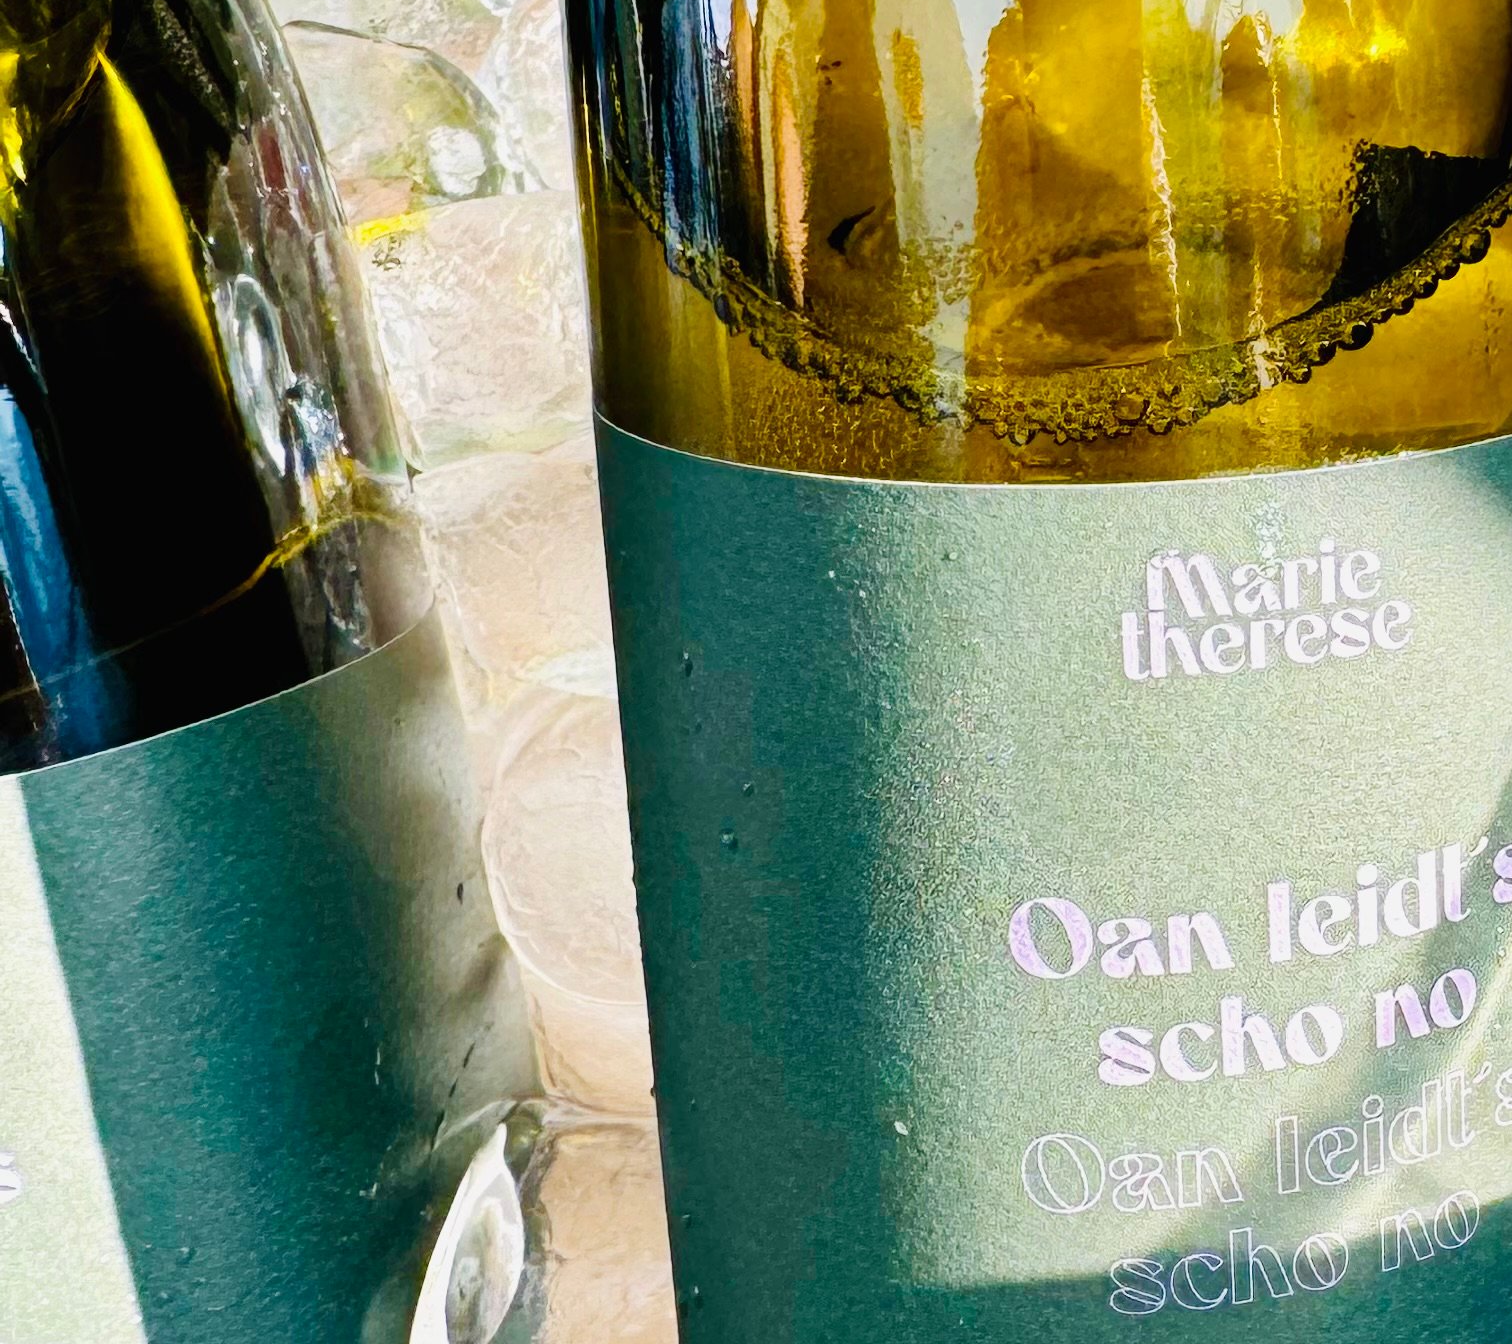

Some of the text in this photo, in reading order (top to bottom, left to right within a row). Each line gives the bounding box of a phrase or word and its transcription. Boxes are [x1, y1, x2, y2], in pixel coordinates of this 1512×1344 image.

[1146, 536, 1382, 618] Marie
[1121, 600, 1412, 681] therese
[1008, 897, 1235, 979] Oan
[1098, 968, 1477, 1086] scho no
[1021, 1133, 1243, 1215] Oan
[1109, 1190, 1480, 1315] scho no
